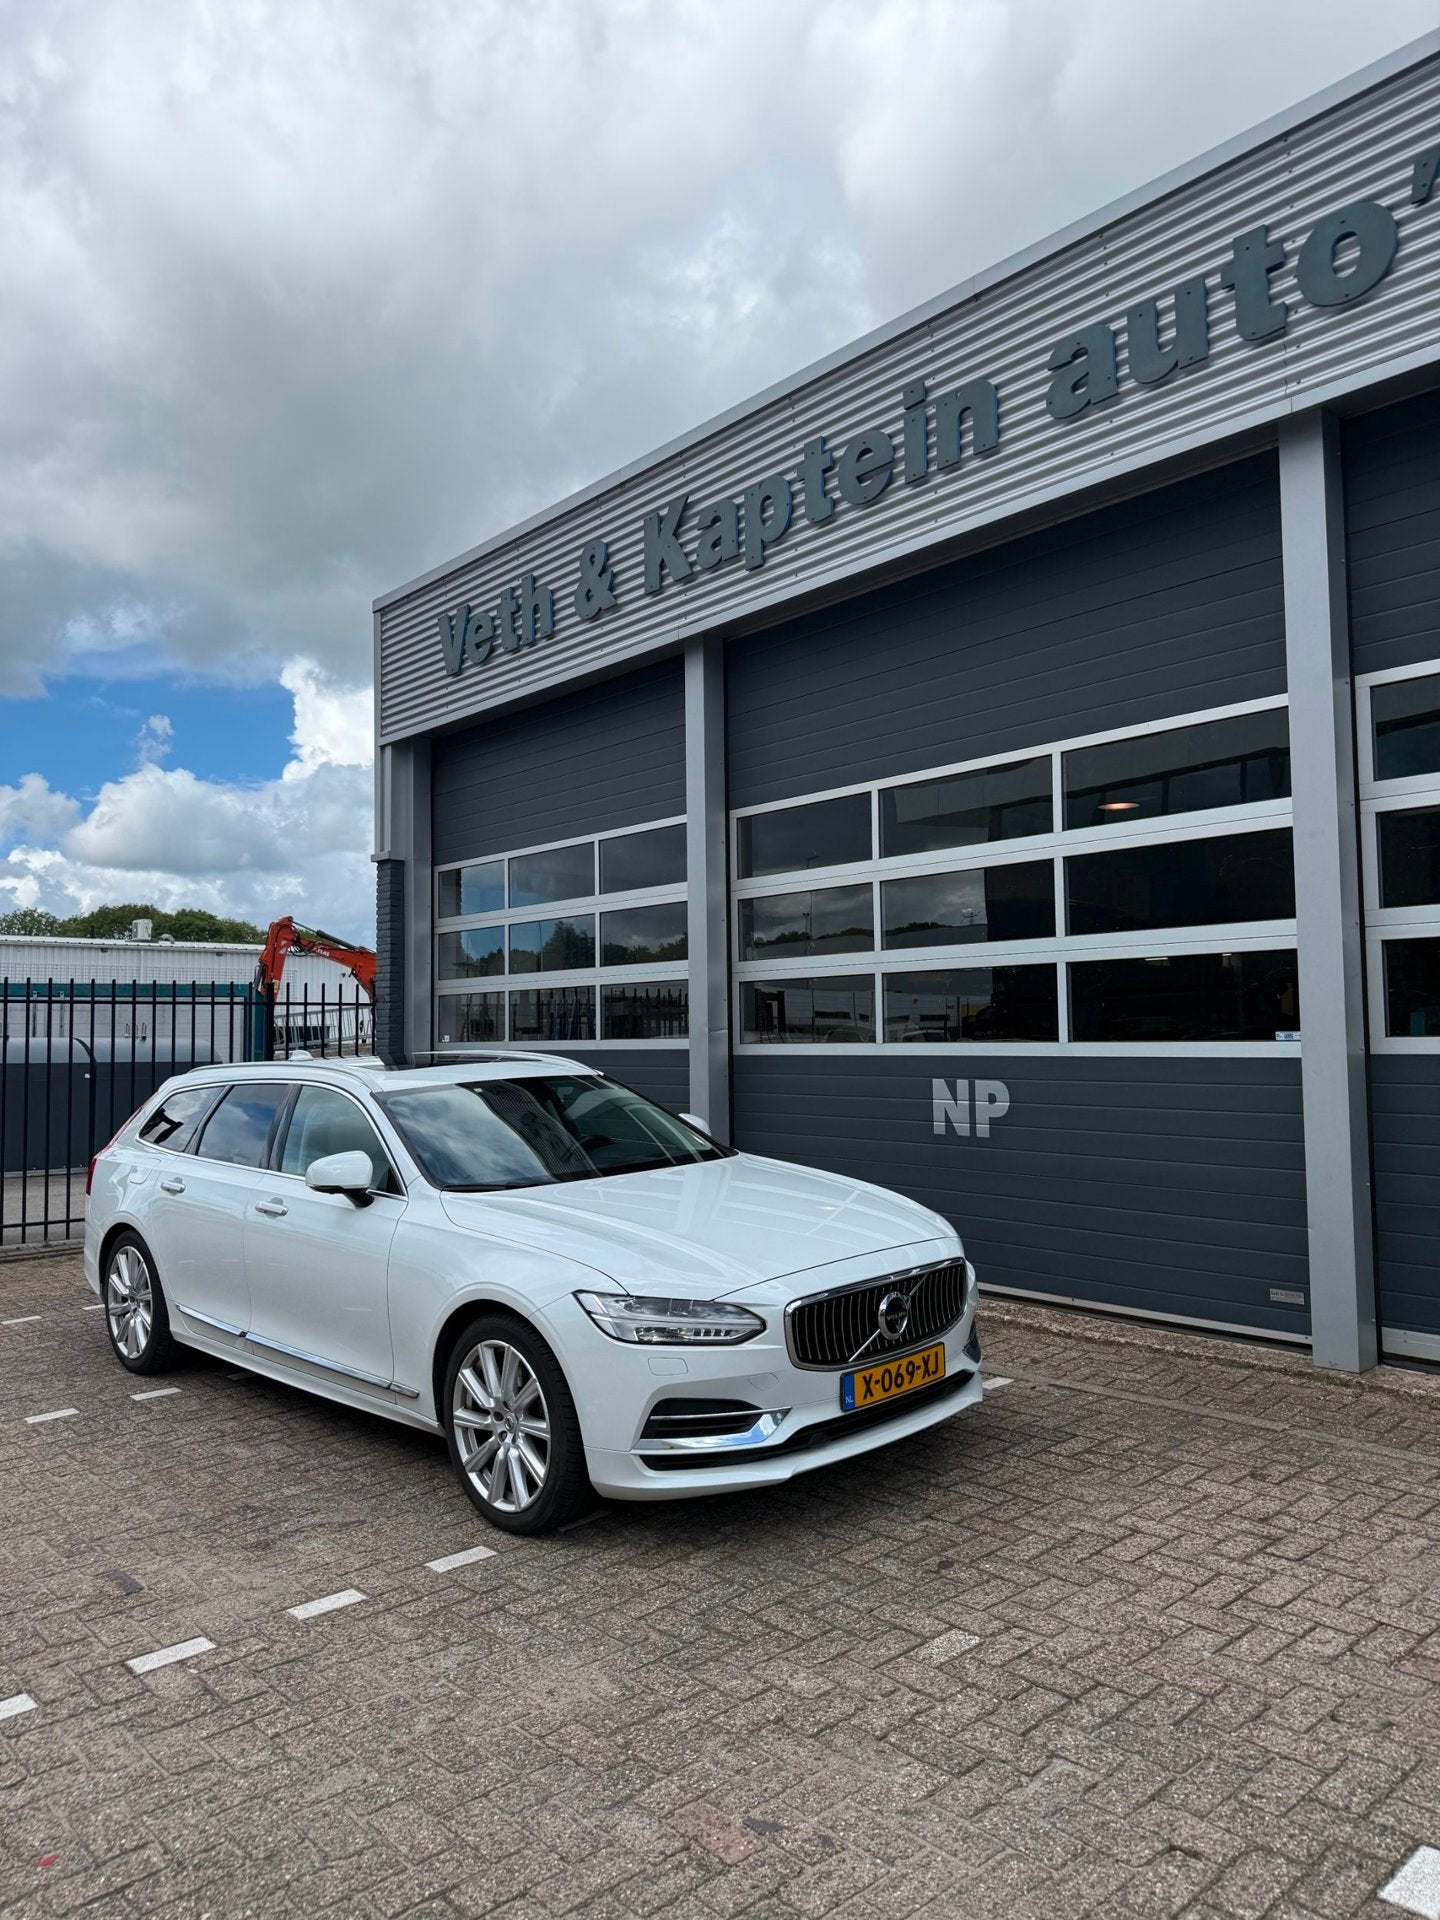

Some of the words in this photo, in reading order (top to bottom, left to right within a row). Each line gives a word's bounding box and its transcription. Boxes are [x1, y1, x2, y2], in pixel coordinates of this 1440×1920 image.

[438, 574, 555, 677] Veth
[574, 539, 618, 620] &
[643, 378, 999, 595] Kaptein
[932, 1078, 1010, 1138] NP
[845, 1395, 854, 1404] NL
[863, 1351, 939, 1400] X-069-XJ
